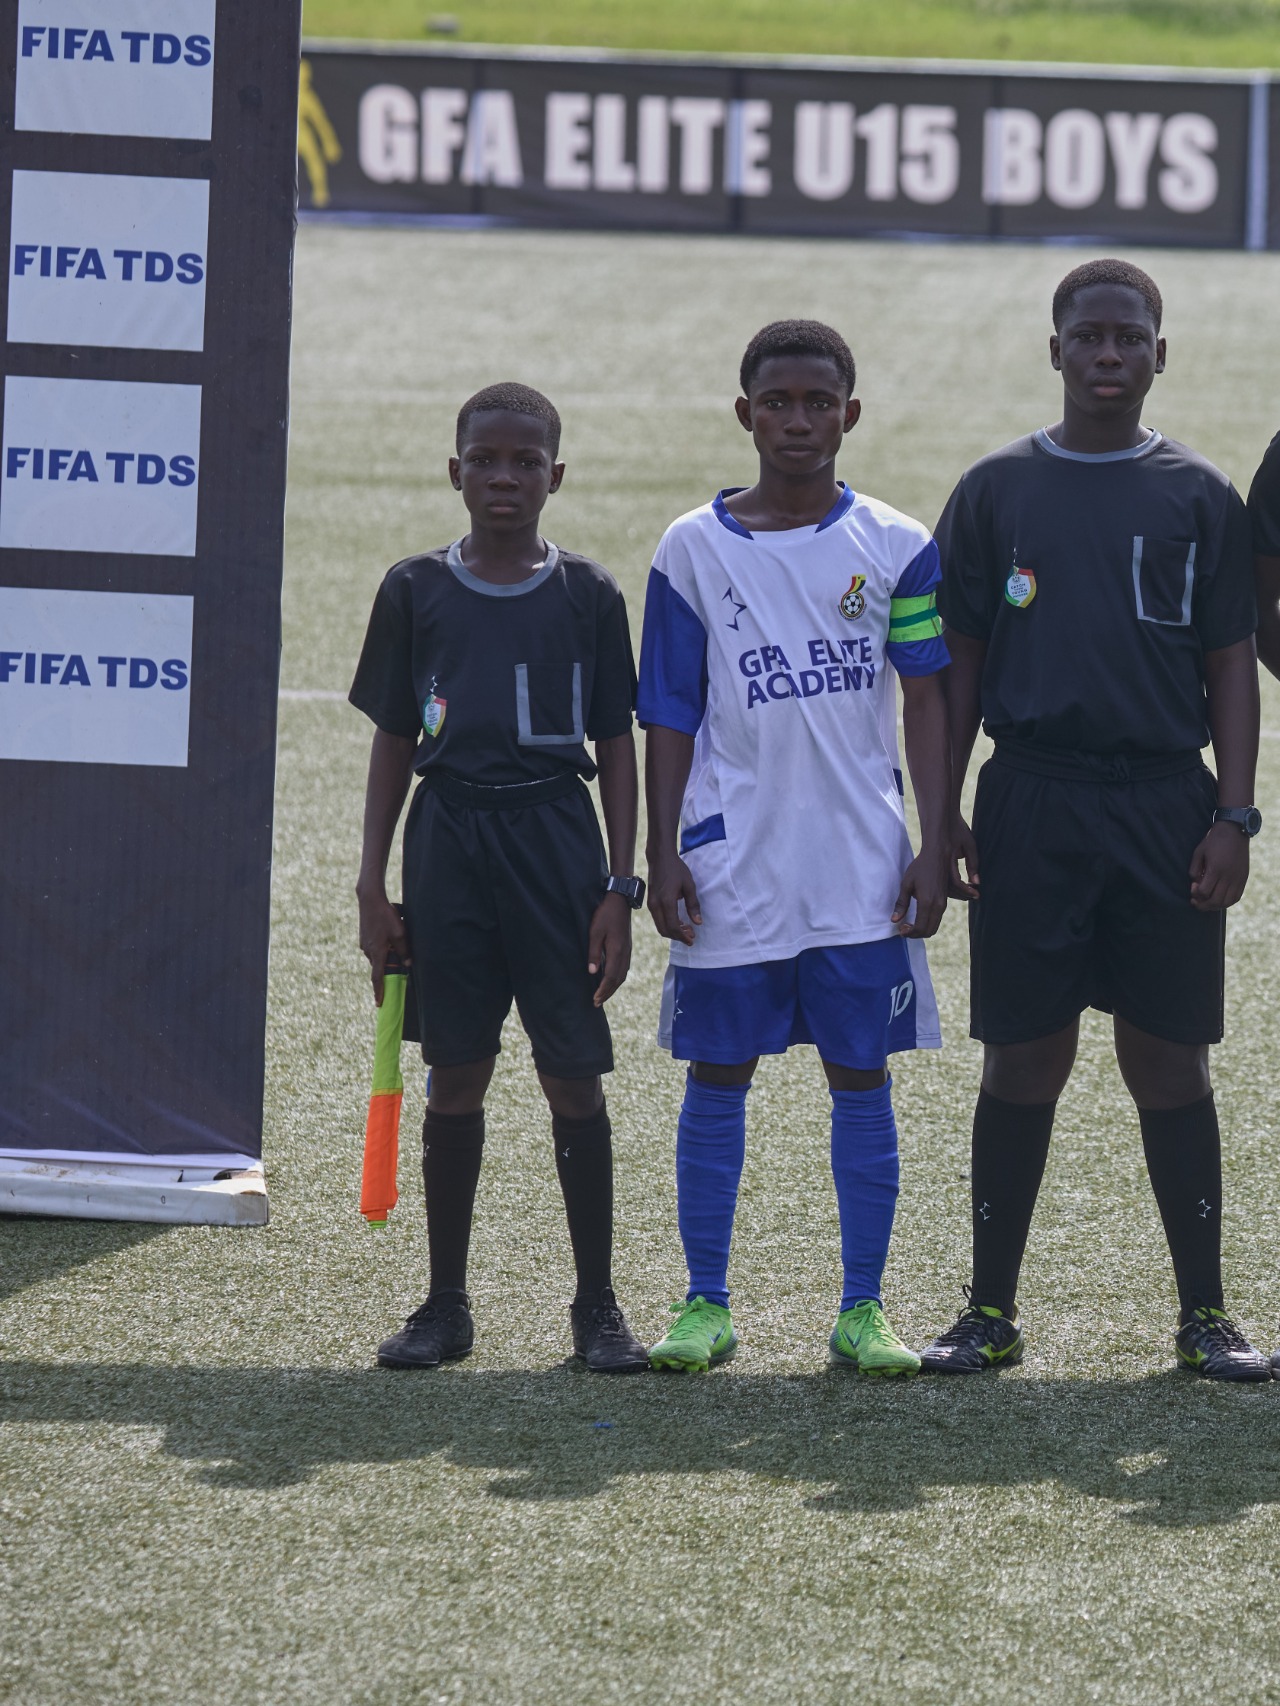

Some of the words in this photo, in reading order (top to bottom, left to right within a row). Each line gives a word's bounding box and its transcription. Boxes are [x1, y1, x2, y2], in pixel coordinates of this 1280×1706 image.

[21, 26, 115, 63] FIFA
[121, 31, 211, 67] TDS
[359, 84, 524, 188] GFA
[544, 92, 772, 196] ELITE
[794, 100, 961, 202] U15
[983, 107, 1219, 212] BOYS
[13, 244, 107, 281] FIFA
[114, 250, 205, 285] TDS
[5, 446, 100, 484] FIFA
[105, 452, 197, 487] TDS
[0, 652, 92, 686] FIFA
[98, 656, 188, 691] TDS
[738, 645, 792, 678] GFA
[807, 636, 873, 667] ELITE
[746, 663, 877, 710] ACADEMY
[887, 980, 914, 1026] 10
